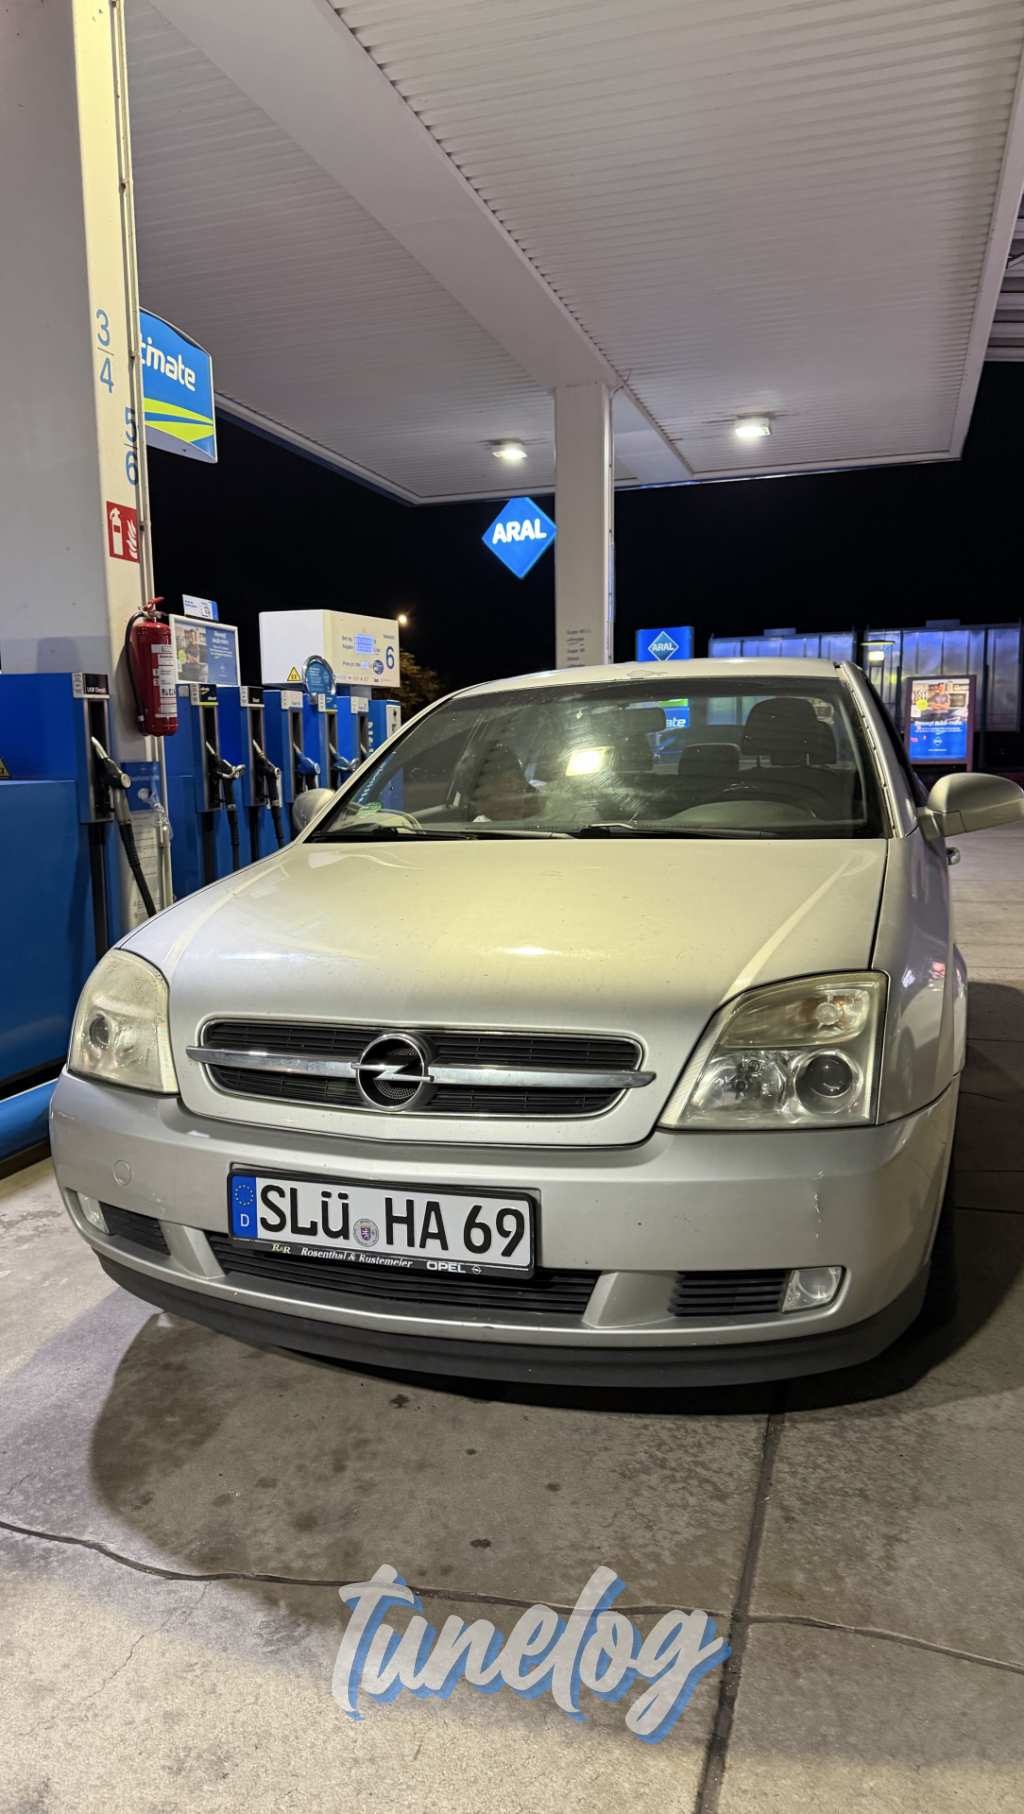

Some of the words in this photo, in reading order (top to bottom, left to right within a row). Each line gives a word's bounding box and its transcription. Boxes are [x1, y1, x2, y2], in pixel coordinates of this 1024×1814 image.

[96, 309, 110, 346] 3
[100, 358, 114, 394] 4
[125, 406, 138, 443] 5
[125, 451, 139, 485] 6
[492, 518, 547, 544] ARAL
[386, 646, 395, 669] 6
[652, 642, 674, 652] ARAL
[240, 1213, 250, 1227] D
[384, 1197, 449, 1250] HA
[463, 1204, 525, 1257] 69
[300, 1247, 347, 1260] Rosenthal
[348, 1252, 356, 1262] &
[426, 1261, 466, 1274] OPEL
